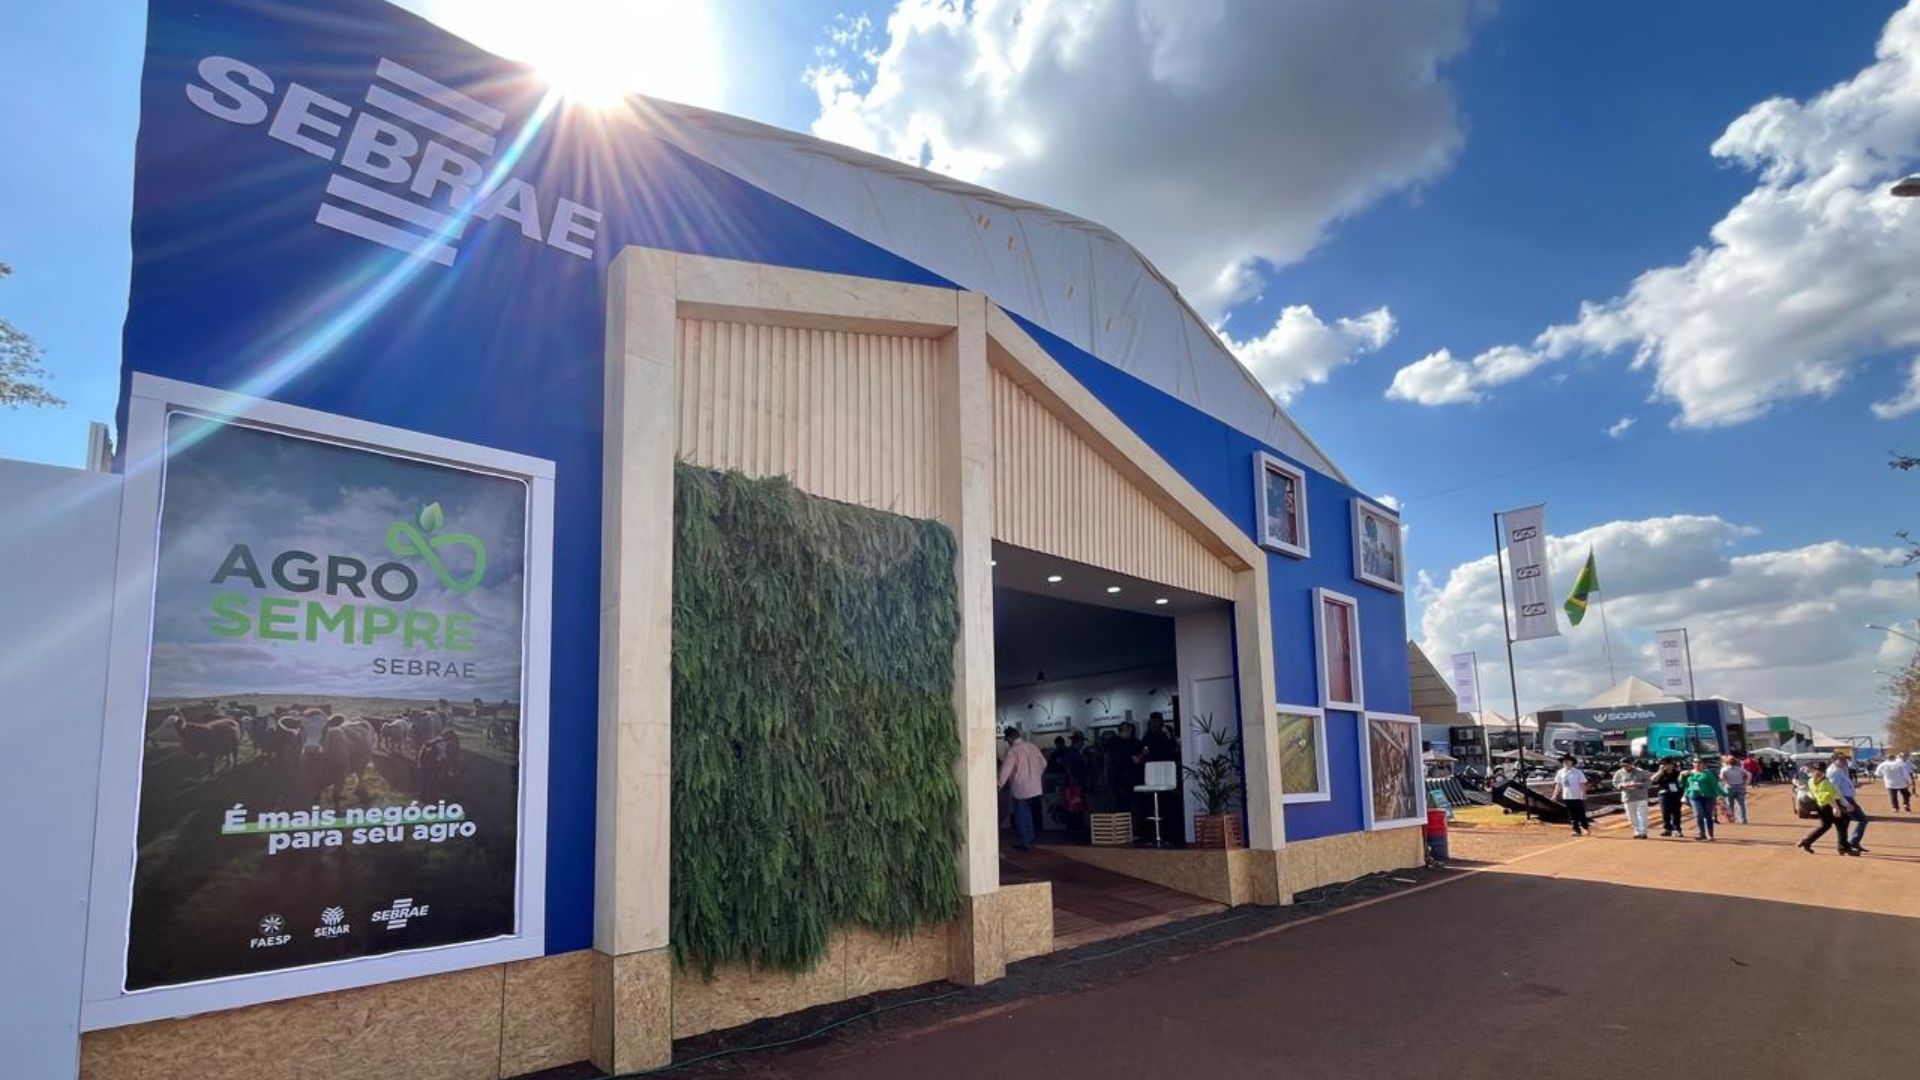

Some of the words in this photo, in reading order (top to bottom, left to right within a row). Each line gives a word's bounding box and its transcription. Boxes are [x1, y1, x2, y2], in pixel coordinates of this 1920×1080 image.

[186, 55, 602, 260] SEBRAE
[210, 543, 419, 602] AGRO
[208, 591, 481, 651] SEMPRE
[372, 657, 477, 679] SEBRAE
[1607, 710, 1656, 721] SCANIA
[224, 803, 248, 832] É
[257, 805, 337, 831] mais
[345, 800, 464, 826] negócio
[268, 827, 343, 856] para
[352, 825, 405, 845] seu
[412, 820, 477, 843] agro
[371, 904, 430, 922] SEBRAE
[250, 934, 293, 949] FAESP
[314, 924, 350, 938] SENAR
